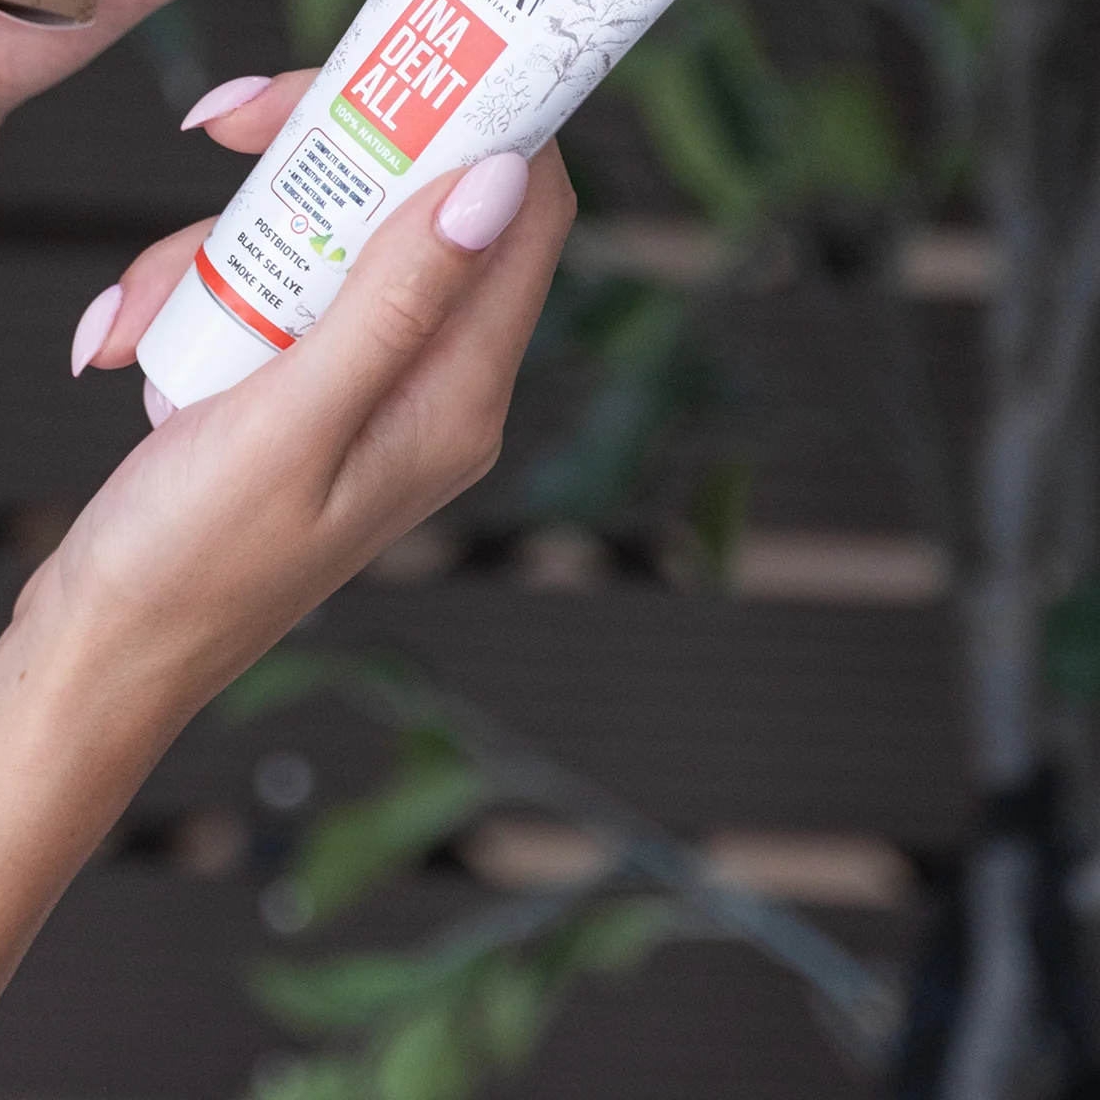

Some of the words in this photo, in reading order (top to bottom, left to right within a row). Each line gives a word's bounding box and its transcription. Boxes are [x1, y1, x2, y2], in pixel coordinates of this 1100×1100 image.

[379, 24, 468, 110] DENT
[350, 62, 412, 131] ALL
[334, 104, 360, 131] 100%
[358, 126, 403, 171] NATURAL
[290, 171, 327, 210] ANTI-BACTERIAL
[298, 161, 321, 186] SENSITIVE
[320, 182, 334, 196] GUM
[331, 192, 347, 208] CARE
[306, 150, 328, 173] SOOTHES
[325, 169, 351, 194] BLEEDING
[315, 140, 340, 166] COMPLETE
[336, 160, 351, 178] ORAL
[349, 173, 373, 197] HYGIENE
[282, 181, 304, 204] REDUCES
[301, 199, 313, 214] BAD
[311, 210, 333, 231] BREATH
[237, 231, 265, 262] BLACK
[262, 258, 283, 280] SEA
[282, 276, 304, 297] LYE
[254, 217, 311, 272] POSTBIOTIC+
[227, 254, 258, 287] SMOKE
[256, 283, 284, 310] TREE
